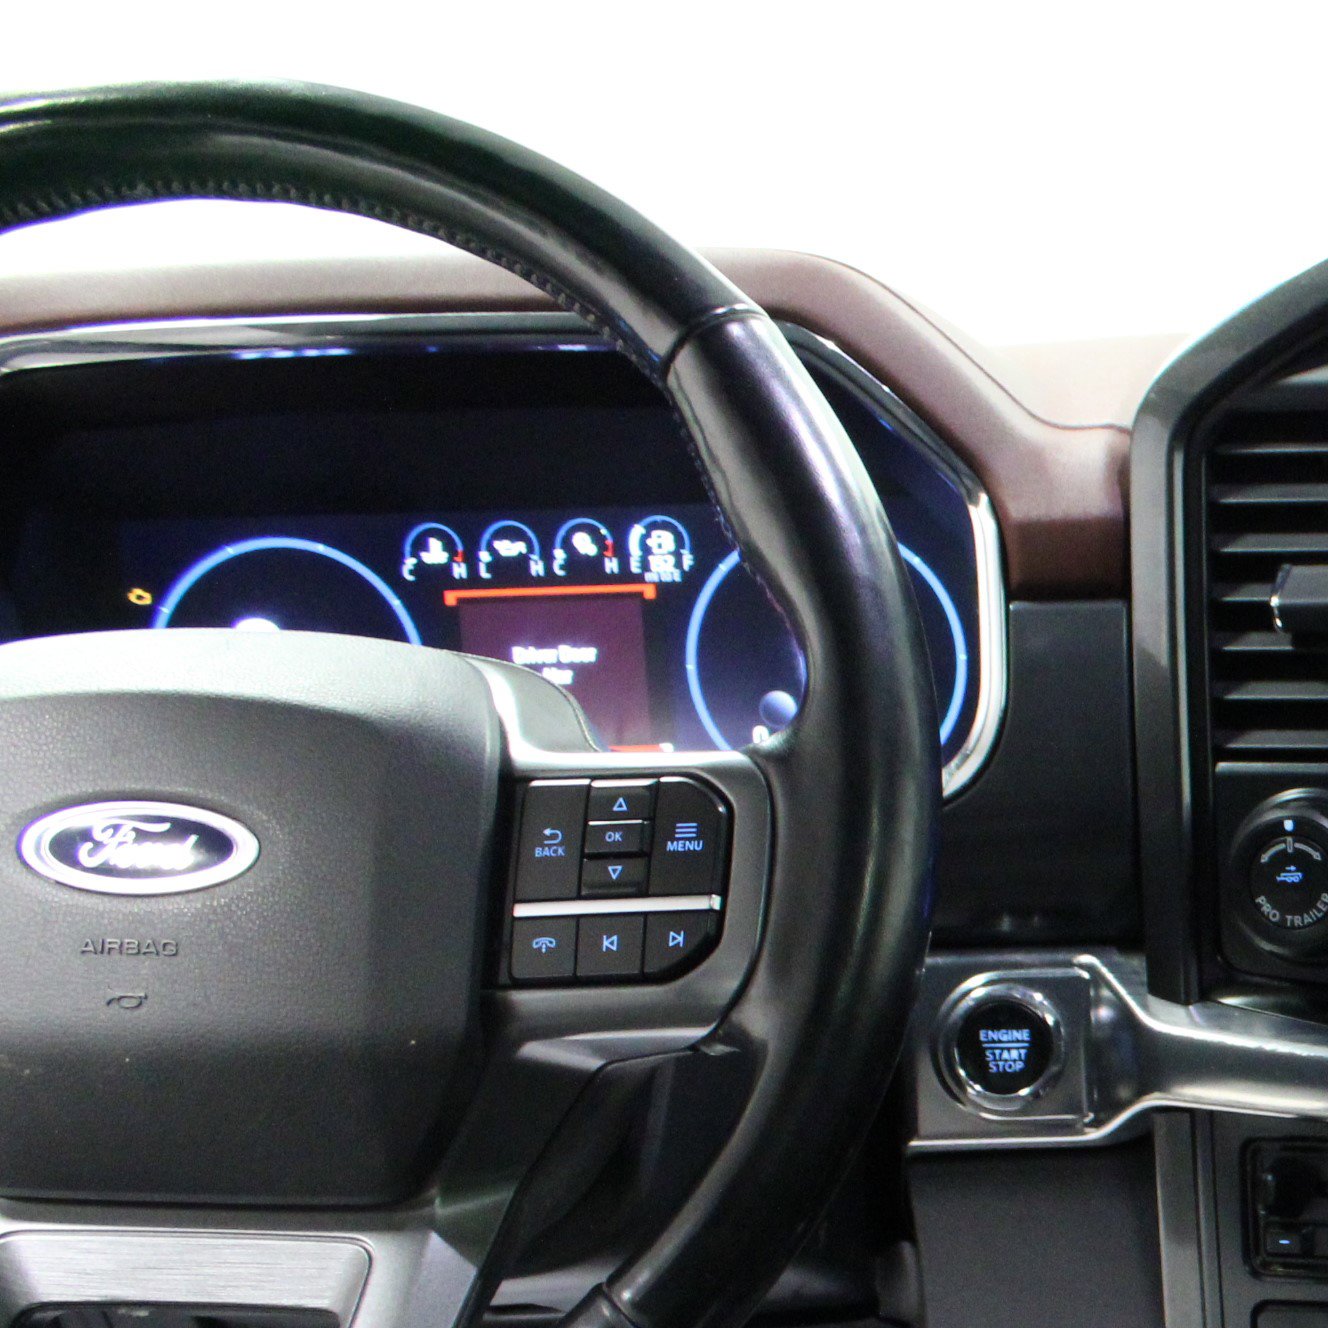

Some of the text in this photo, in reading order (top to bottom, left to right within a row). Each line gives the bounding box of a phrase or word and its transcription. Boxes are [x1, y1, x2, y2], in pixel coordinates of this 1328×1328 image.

[452, 561, 468, 579] H
[604, 557, 619, 575] H
[605, 831, 623, 843] OK
[78, 818, 198, 871] Ford
[666, 840, 704, 852] MENU
[534, 846, 566, 858] BACK
[1255, 895, 1280, 923] PRO
[80, 937, 180, 957] AIRBAG
[979, 1028, 1032, 1042] ENGINE
[984, 1048, 1028, 1061] START
[988, 1060, 1026, 1073] STOP
